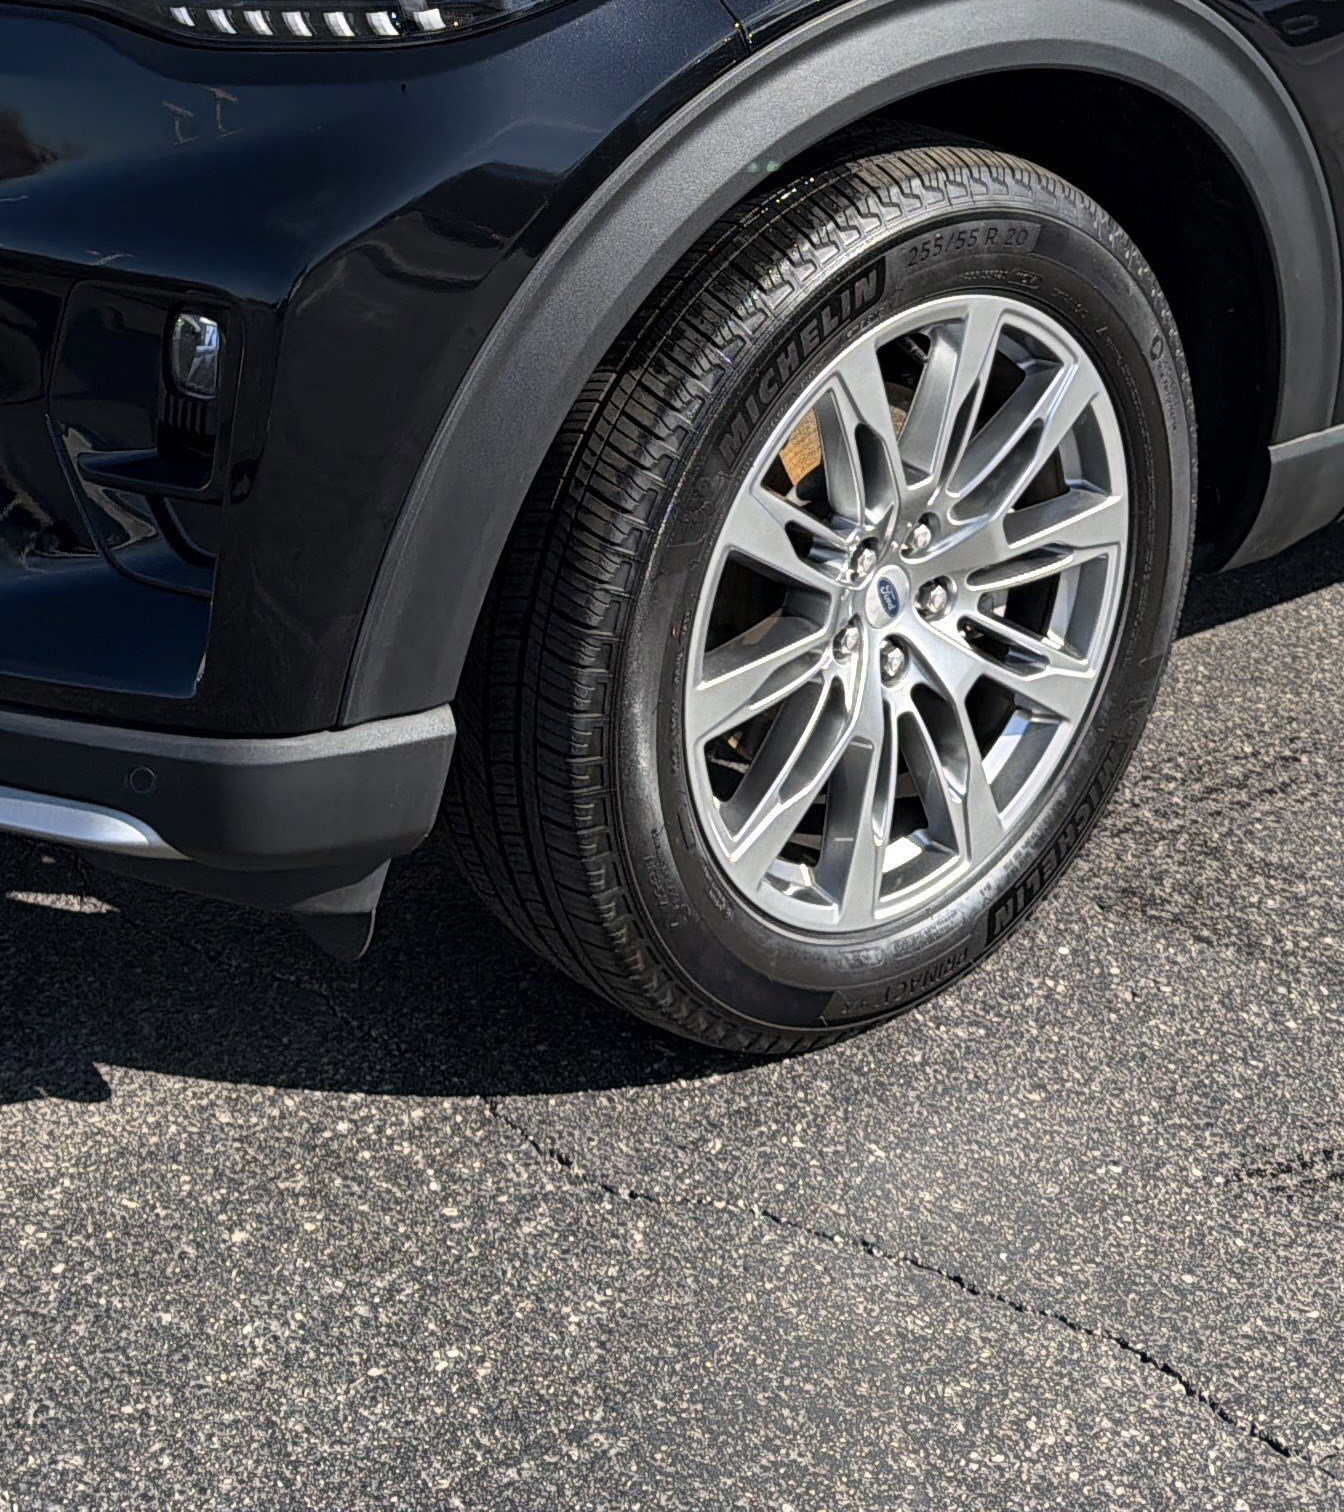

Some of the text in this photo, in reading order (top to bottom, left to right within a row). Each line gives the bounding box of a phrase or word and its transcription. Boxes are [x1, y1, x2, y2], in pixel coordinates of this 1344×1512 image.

[907, 227, 1029, 268] 255/55 R 20
[718, 267, 879, 463] MICHELIN
[880, 584, 897, 611] Ford
